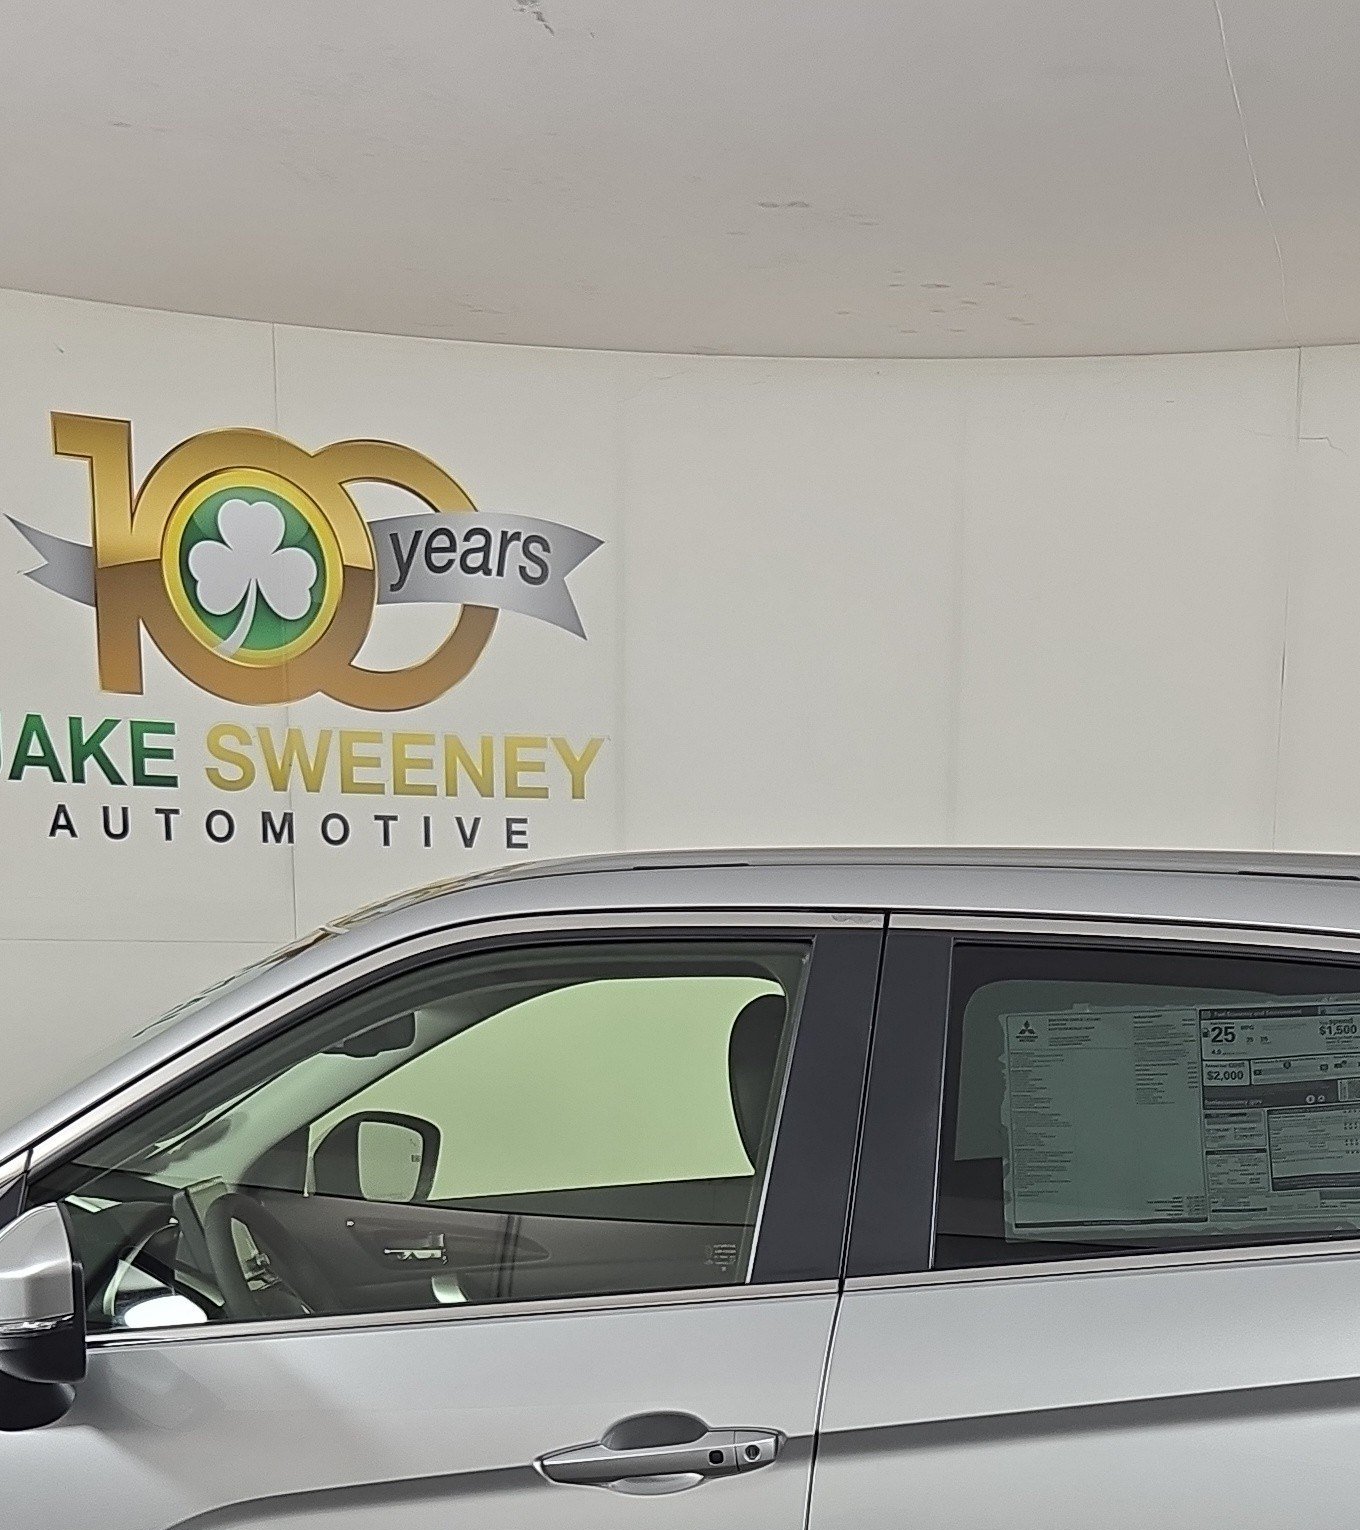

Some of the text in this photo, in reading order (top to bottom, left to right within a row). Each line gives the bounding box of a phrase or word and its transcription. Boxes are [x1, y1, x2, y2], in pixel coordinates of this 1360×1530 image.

[50, 411, 499, 712] 100
[388, 524, 551, 592] years
[206, 724, 606, 800] SWEENEY
[49, 804, 530, 850] AUTOMOTIVE
[1210, 1026, 1236, 1043] 25
[1319, 1025, 1357, 1036] $1,500
[1207, 1071, 1244, 1081] $2,000
